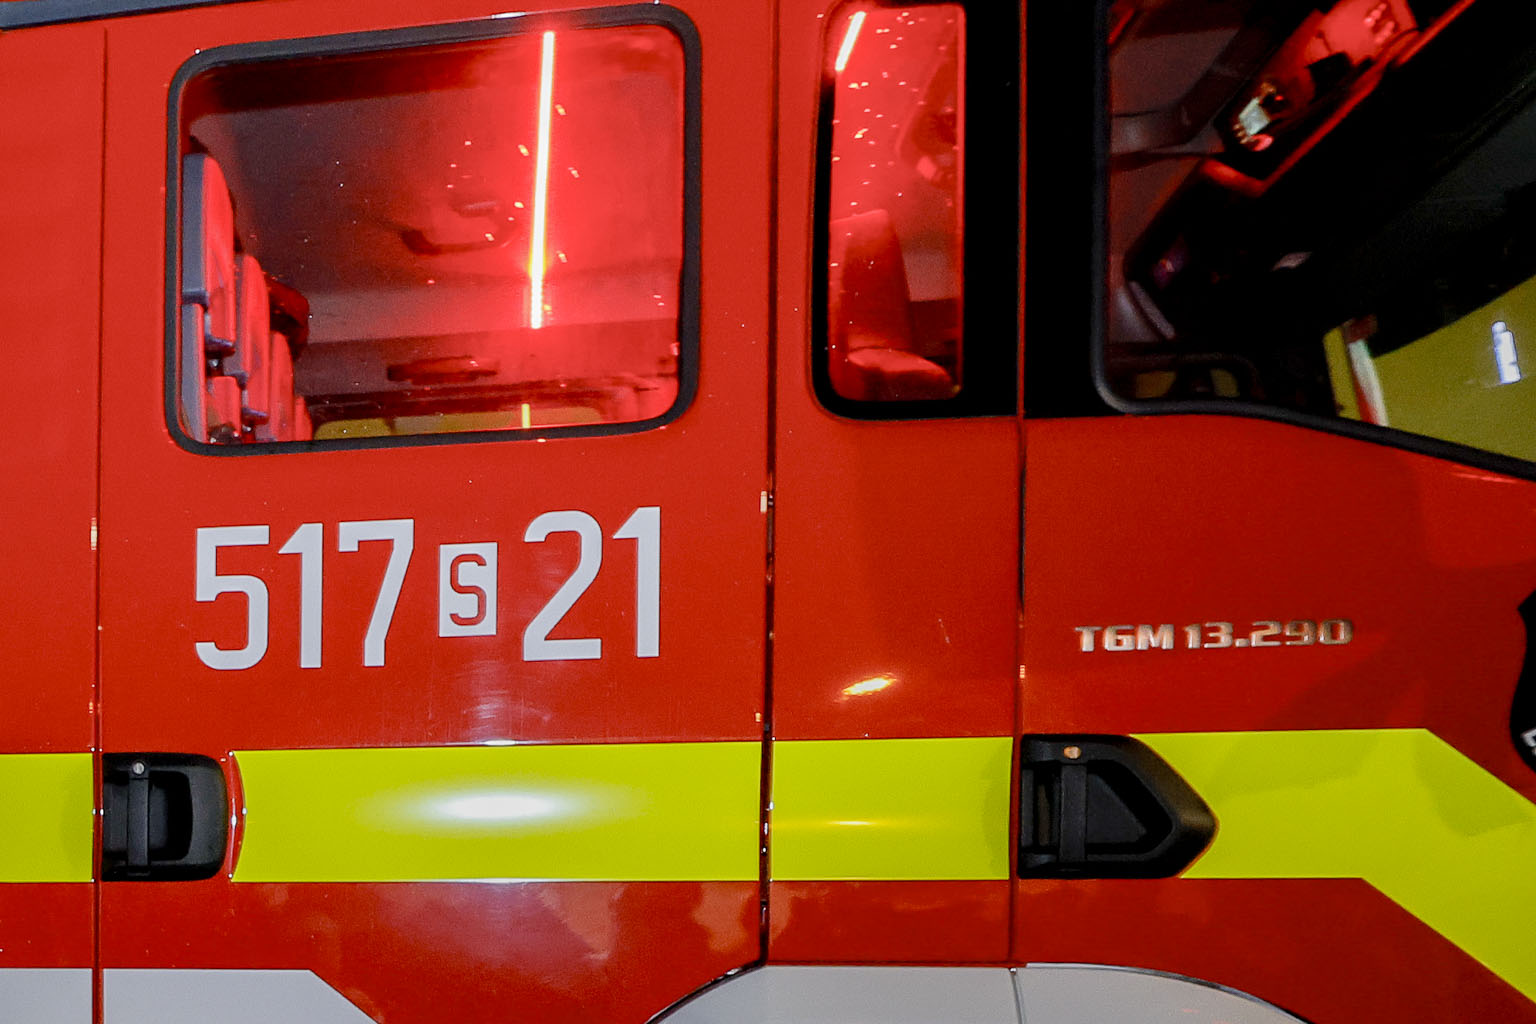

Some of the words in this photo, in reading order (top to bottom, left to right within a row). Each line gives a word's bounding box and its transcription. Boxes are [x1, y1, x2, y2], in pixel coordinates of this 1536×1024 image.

[196, 518, 414, 670] 517
[445, 549, 491, 630] S
[523, 506, 661, 661] 21
[1075, 623, 1175, 652] TGM
[1184, 618, 1355, 649] 13.290
